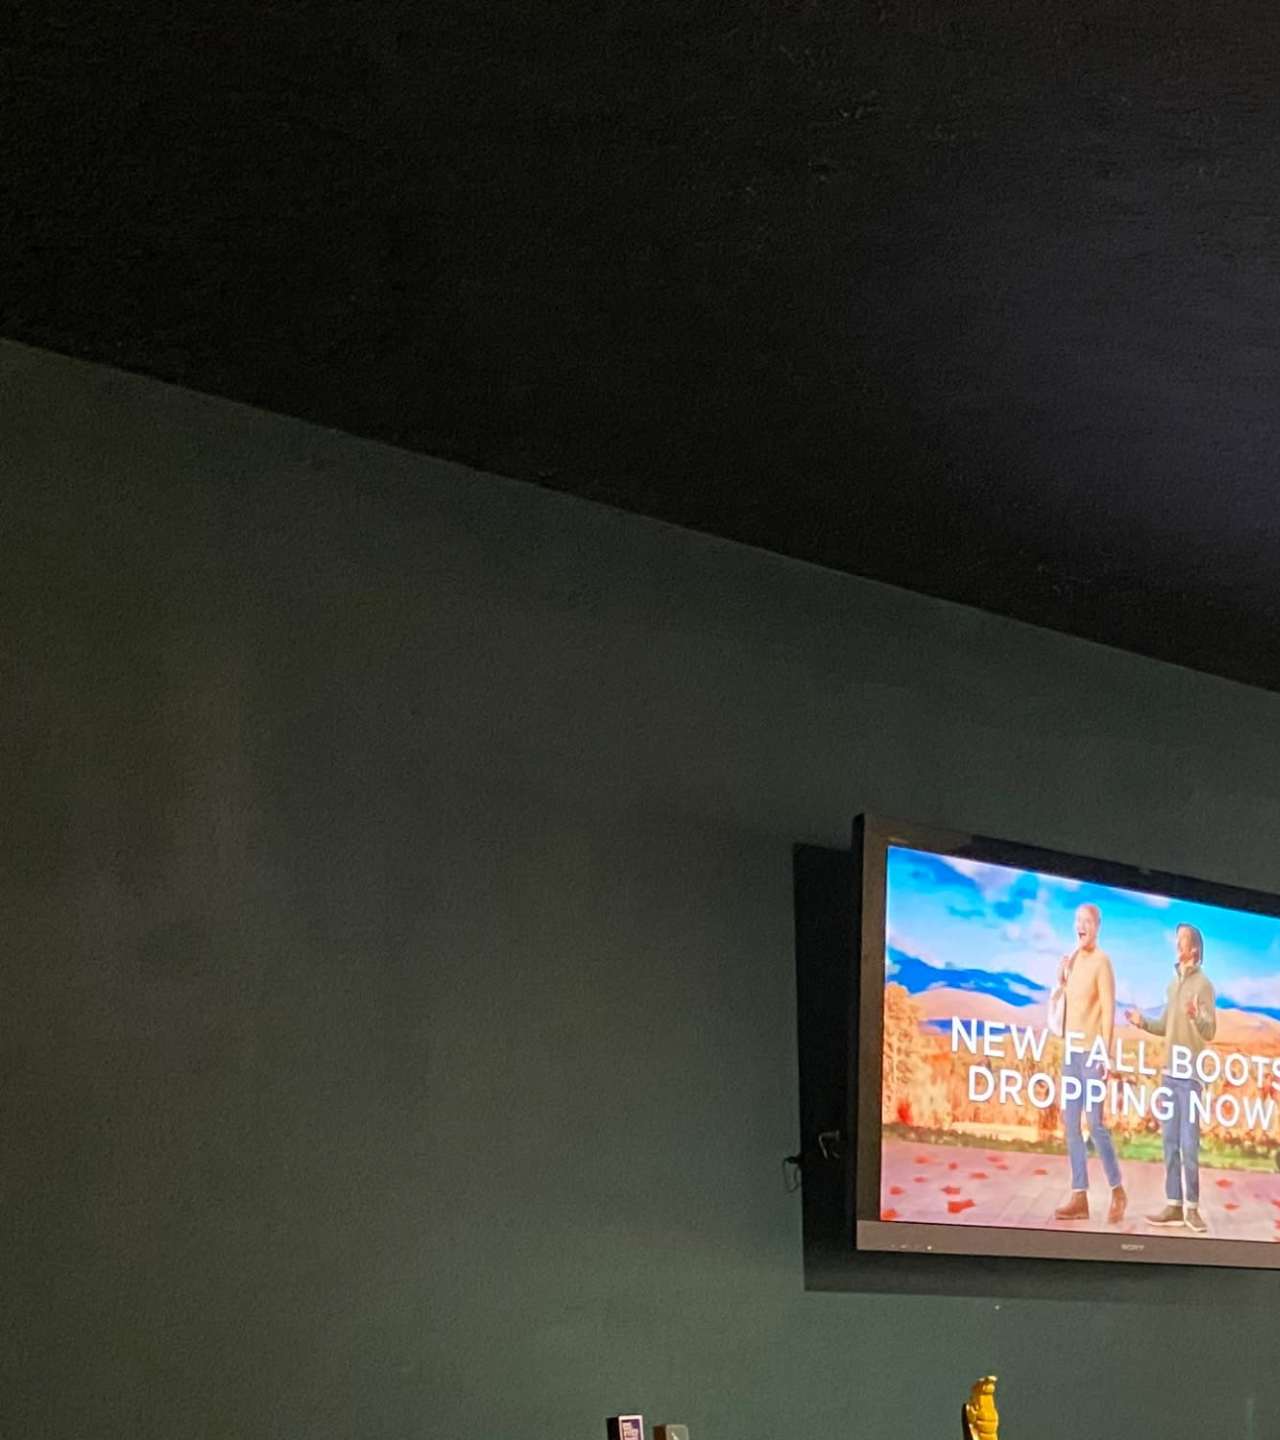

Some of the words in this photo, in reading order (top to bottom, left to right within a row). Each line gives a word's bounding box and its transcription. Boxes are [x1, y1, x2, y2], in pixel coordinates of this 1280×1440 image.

[951, 1016, 1049, 1062] NEW
[1065, 1031, 1157, 1076] FALL
[968, 1065, 1175, 1121] DROPPING
[1189, 1090, 1277, 1131] NOW
